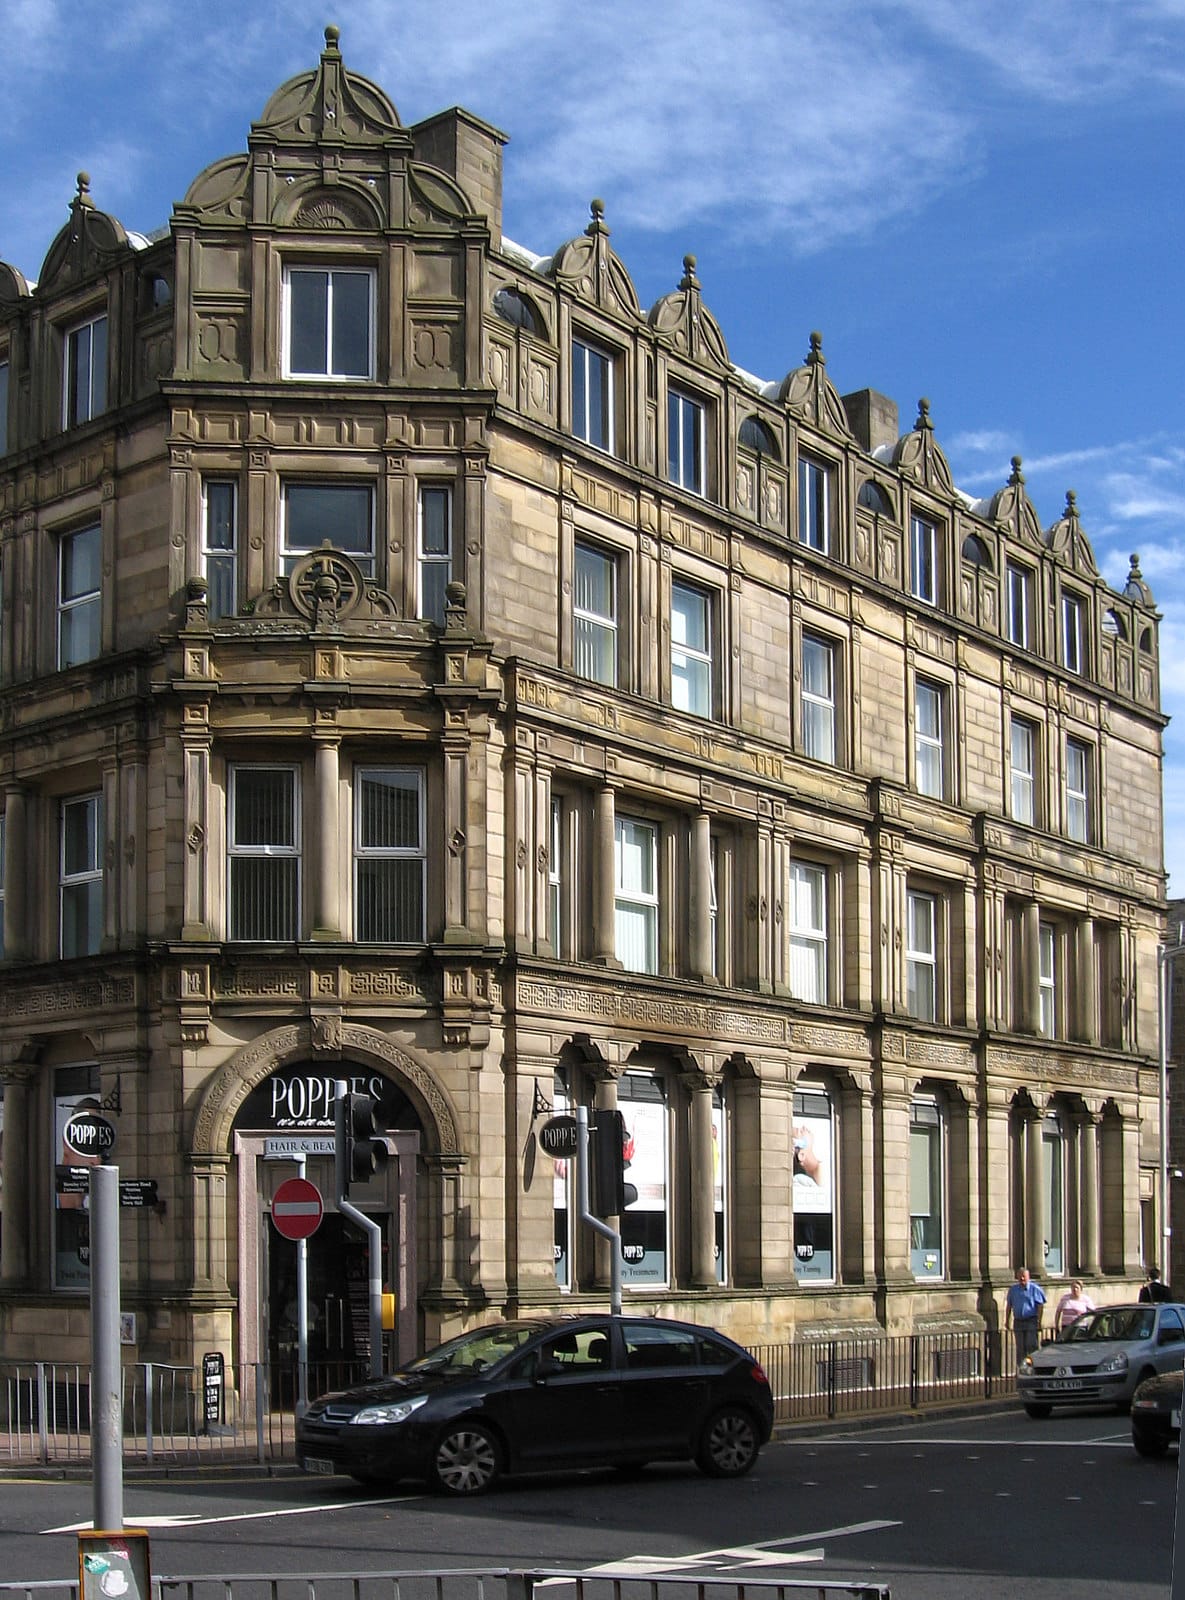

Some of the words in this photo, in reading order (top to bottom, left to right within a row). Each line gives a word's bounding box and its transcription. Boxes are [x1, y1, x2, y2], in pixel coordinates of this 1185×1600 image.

[270, 1077, 383, 1118] POPPS
[70, 1123, 111, 1146] POPPES
[544, 1127, 577, 1148] POPPE
[270, 1141, 297, 1151] HAIR
[301, 1141, 311, 1151] &
[623, 1245, 644, 1258] POPPES
